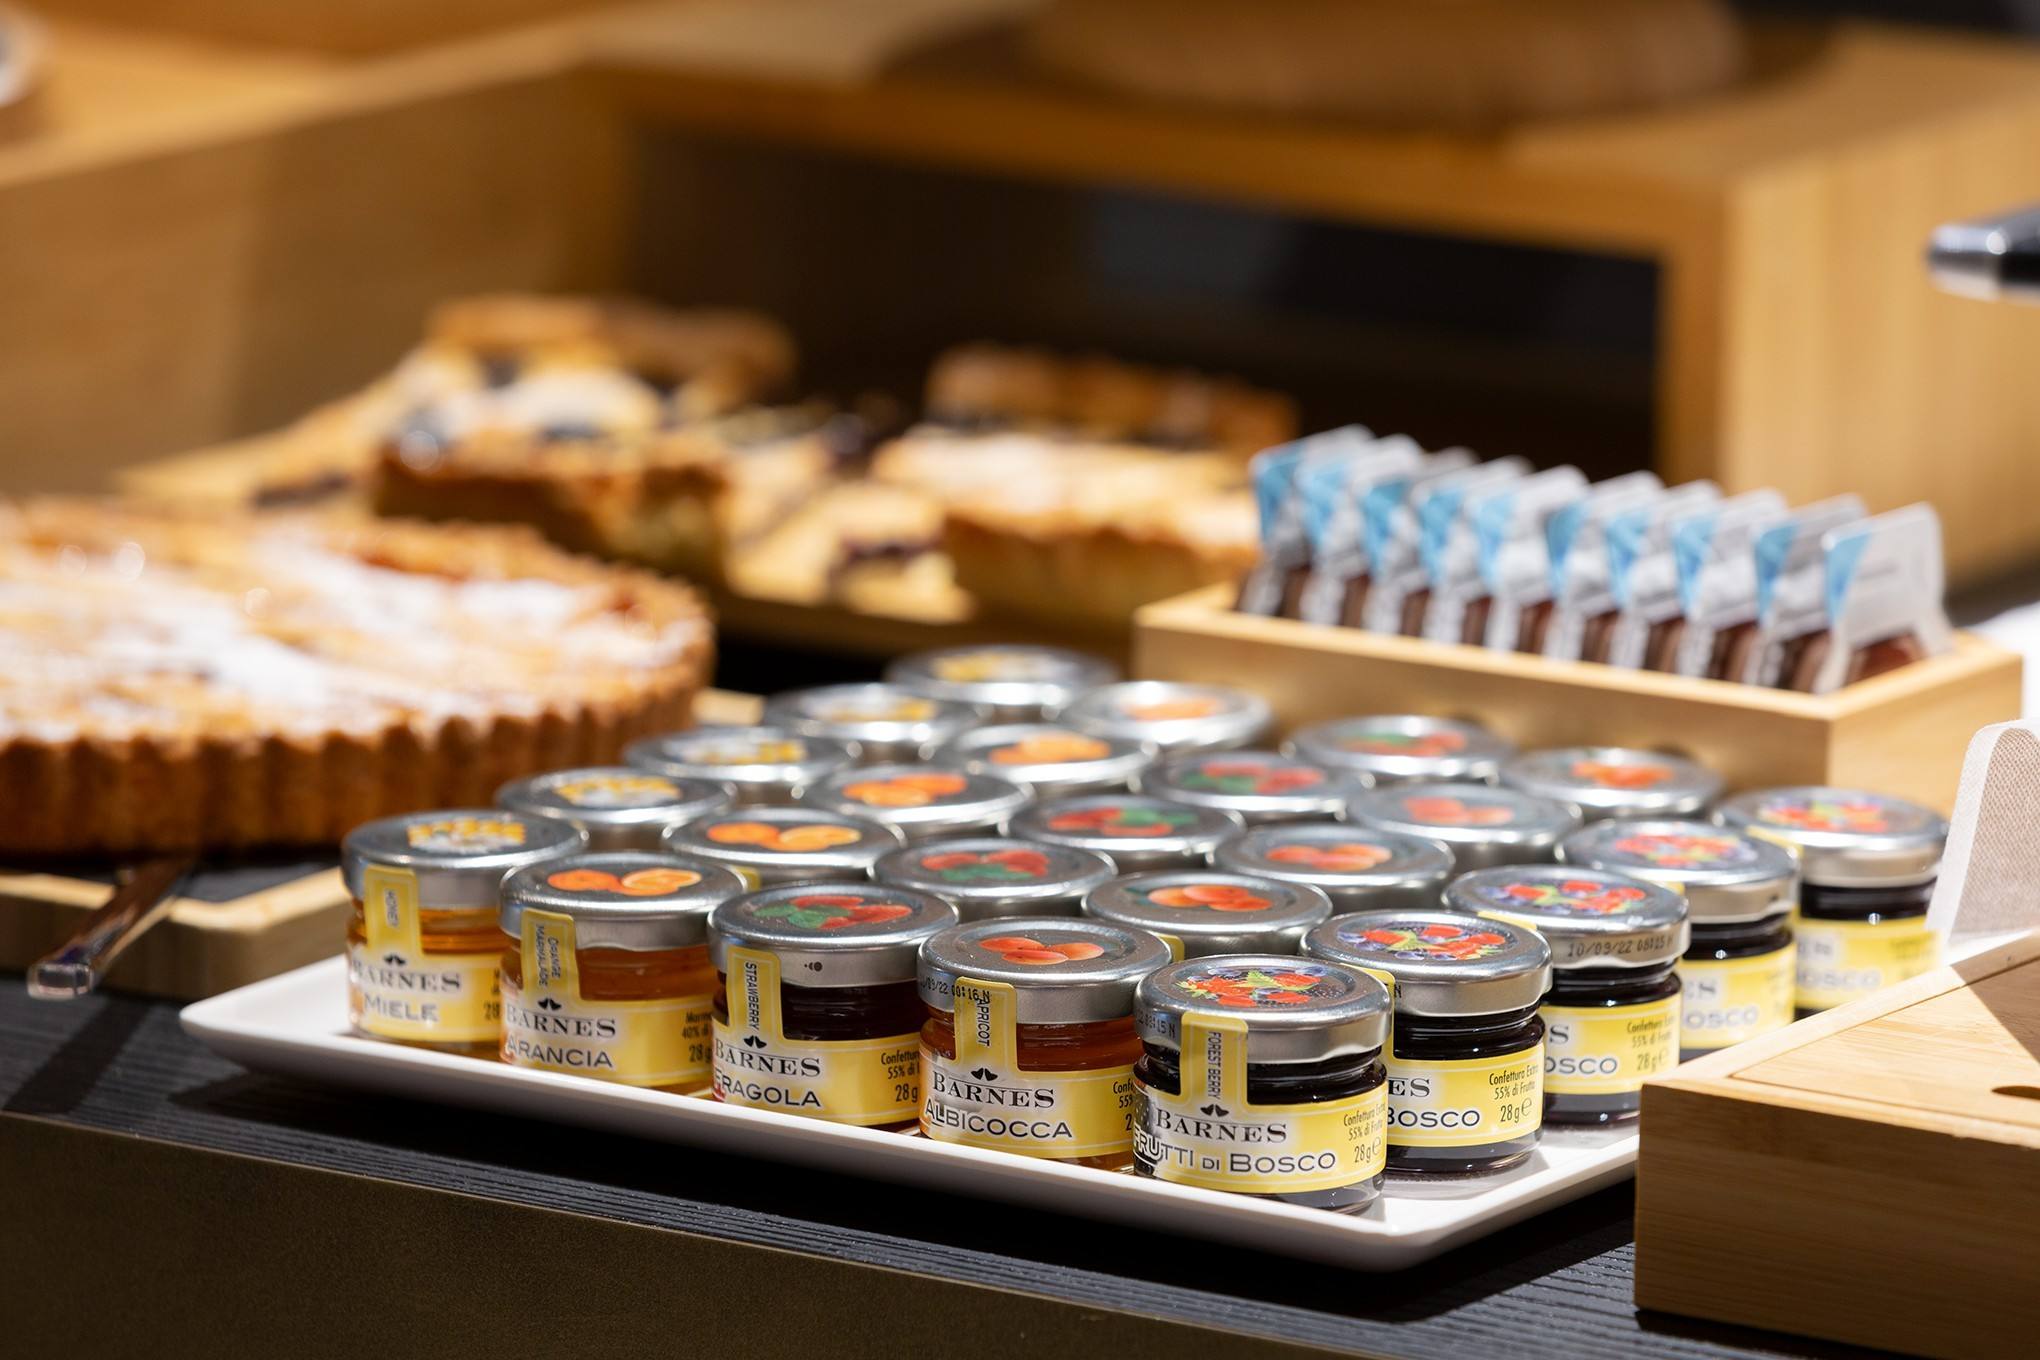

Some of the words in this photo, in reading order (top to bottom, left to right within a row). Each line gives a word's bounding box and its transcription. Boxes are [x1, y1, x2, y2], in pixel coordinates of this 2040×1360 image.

[745, 961, 760, 1032] STRAWBERRY
[507, 1002, 616, 1038] BARNES
[976, 999, 991, 1047] APRICOT
[507, 1034, 613, 1068] ARANCIA
[715, 1038, 821, 1077] BARNES
[1208, 1031, 1221, 1065] FOREST
[714, 1067, 821, 1107] FRAGOLA
[932, 1070, 1055, 1109] BARNES
[1208, 1068, 1221, 1099] BERRY
[1489, 1069, 1526, 1086] Confettura
[1494, 1085, 1511, 1101] 55%
[925, 1098, 1072, 1138] ALBICOCCA
[1156, 1108, 1287, 1143] BARNES
[1348, 1126, 1363, 1142] 55%
[1133, 1124, 1194, 1167] FRUTTI
[1230, 1152, 1336, 1173] BOSCO
